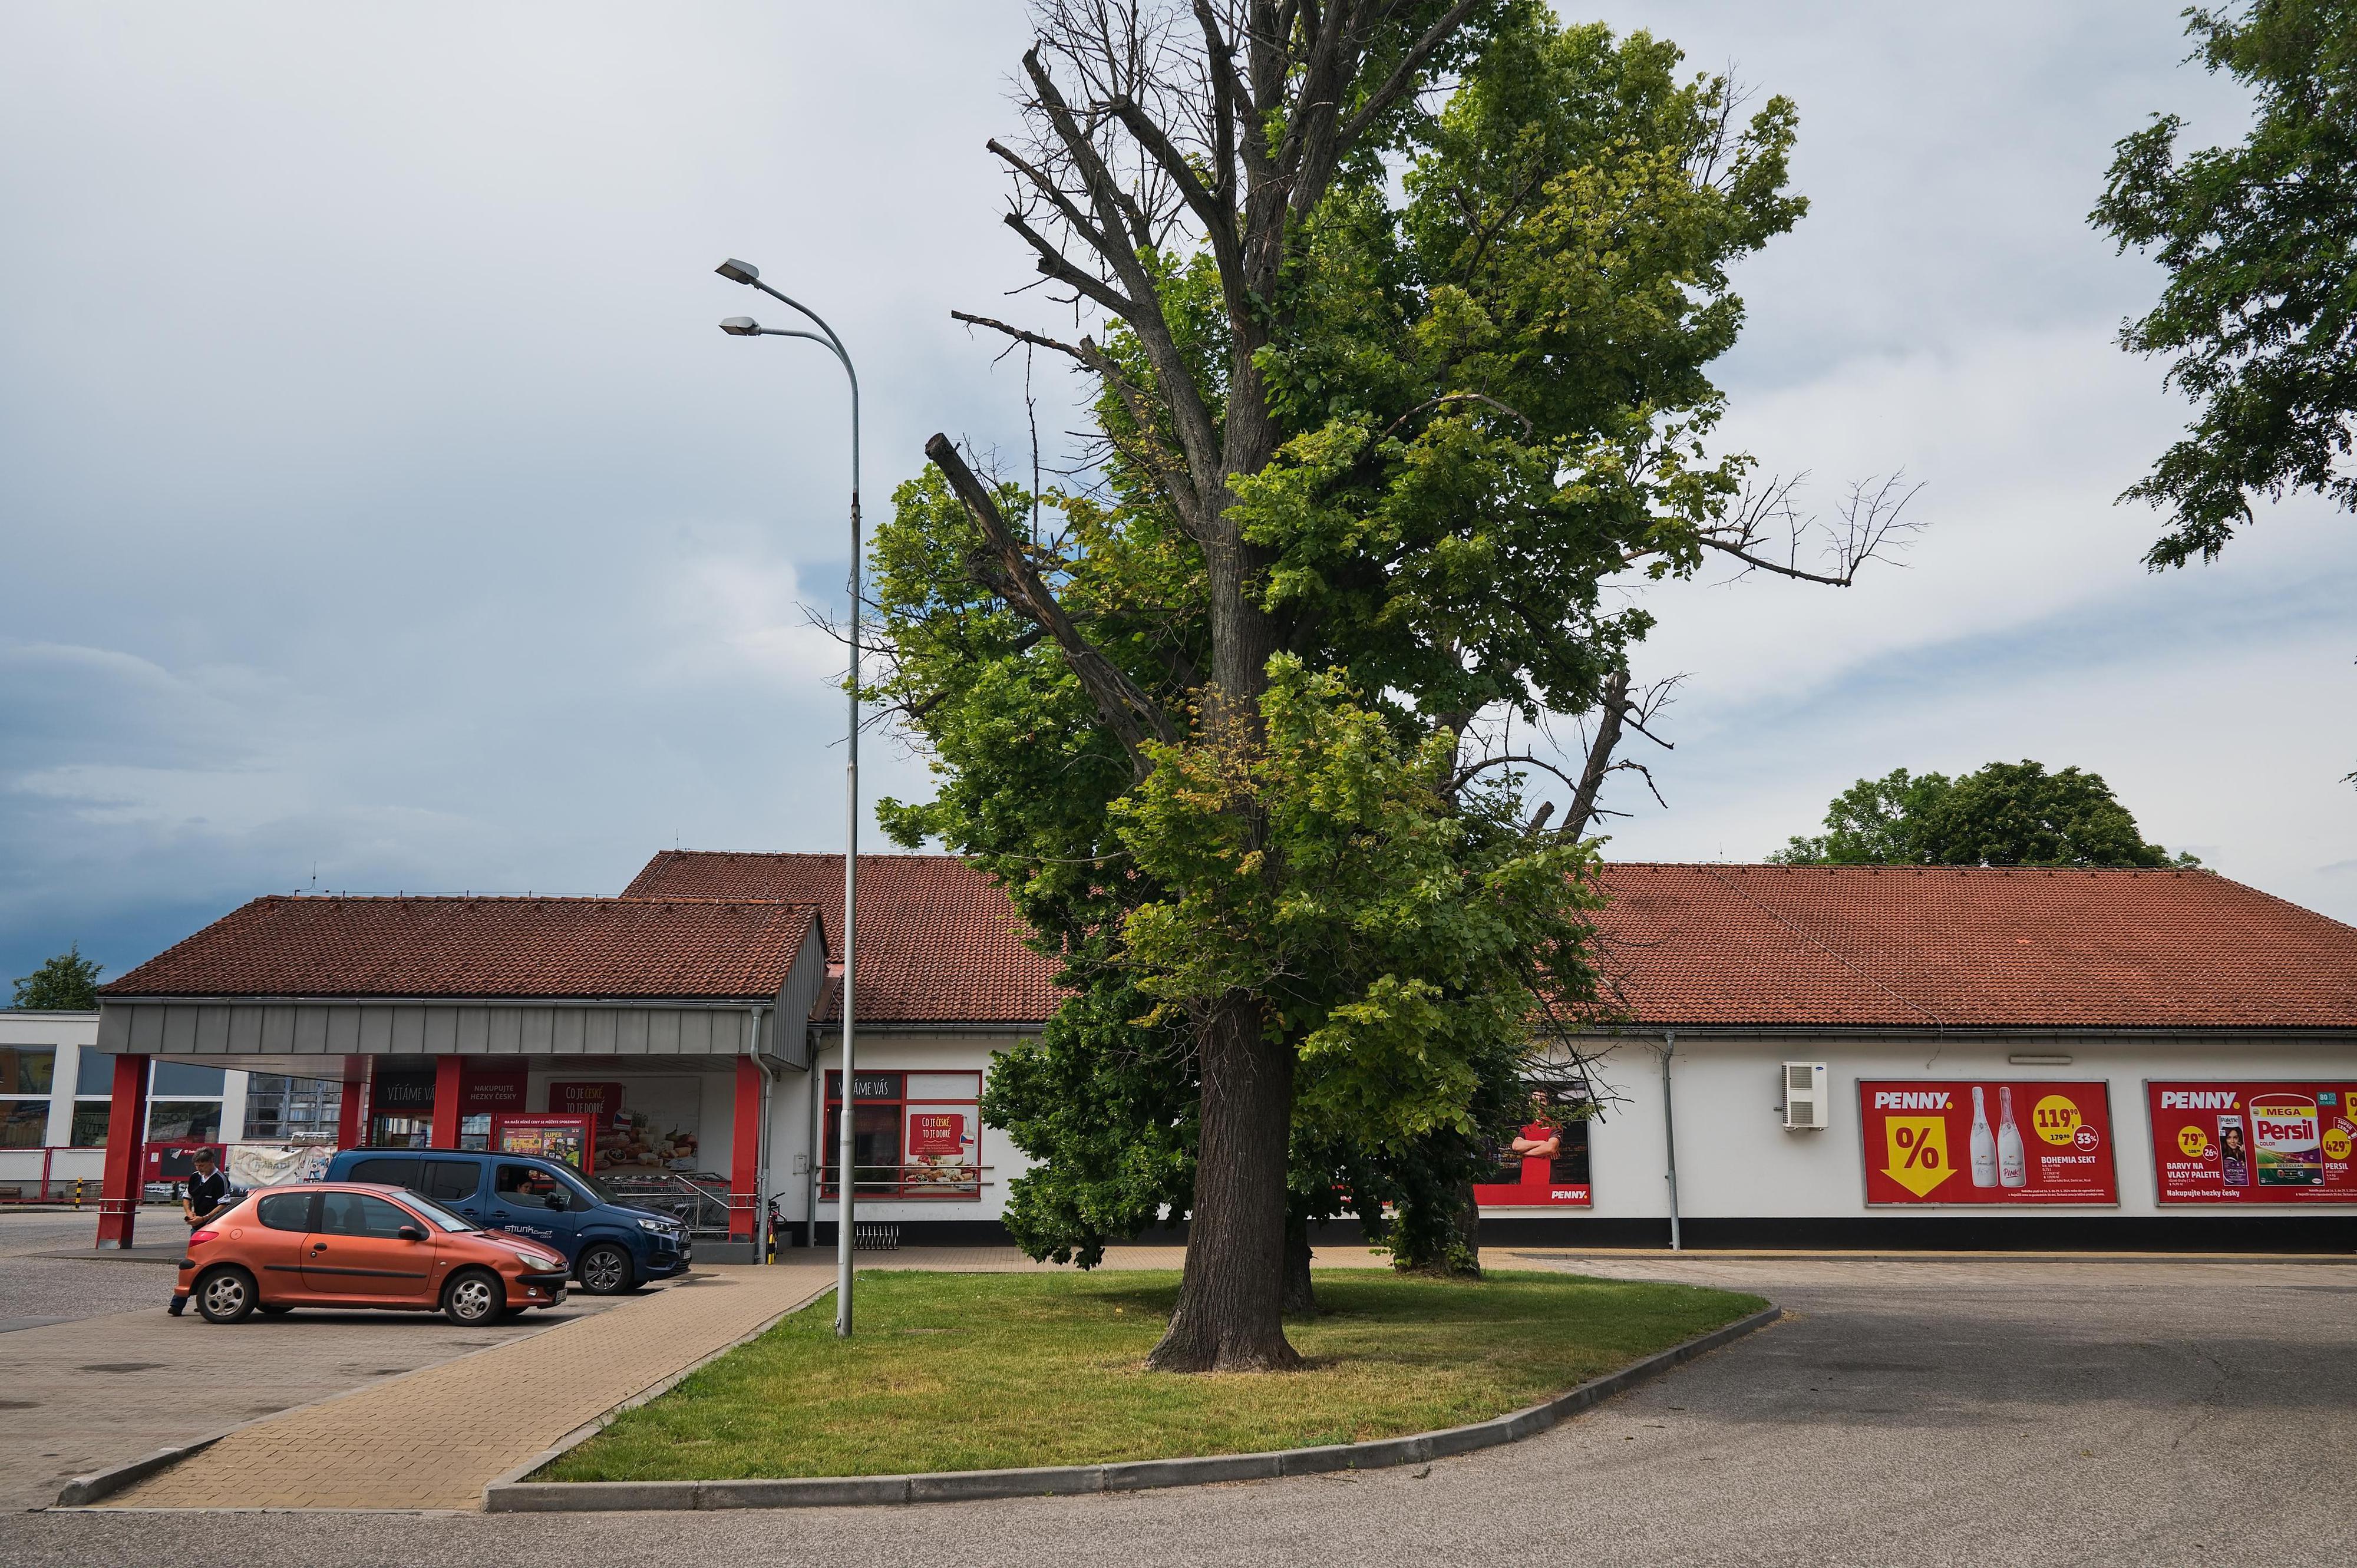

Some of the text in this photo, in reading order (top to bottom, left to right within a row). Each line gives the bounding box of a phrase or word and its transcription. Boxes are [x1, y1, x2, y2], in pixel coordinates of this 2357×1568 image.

[388, 1084, 435, 1101] VÍTÁME VÁ
[838, 1078, 889, 1095] VÁME VÁS
[577, 1088, 584, 1100] JE
[567, 1103, 575, 1113] TO
[585, 1100, 605, 1114] DOBRÉ
[930, 1118, 936, 1128] JE
[936, 1116, 952, 1128] ČESKÉ,
[2338, 1119, 2353, 1131] SUPER
[923, 1127, 952, 1139] TO JE DOBRÉ
[2257, 1119, 2314, 1140] Persil
[2337, 1124, 2349, 1134] CENA
[2077, 1133, 2097, 1144] 33%
[2003, 1168, 2022, 1177] PINK!
[2167, 1189, 2240, 1197] Nakupujte hezky česky
